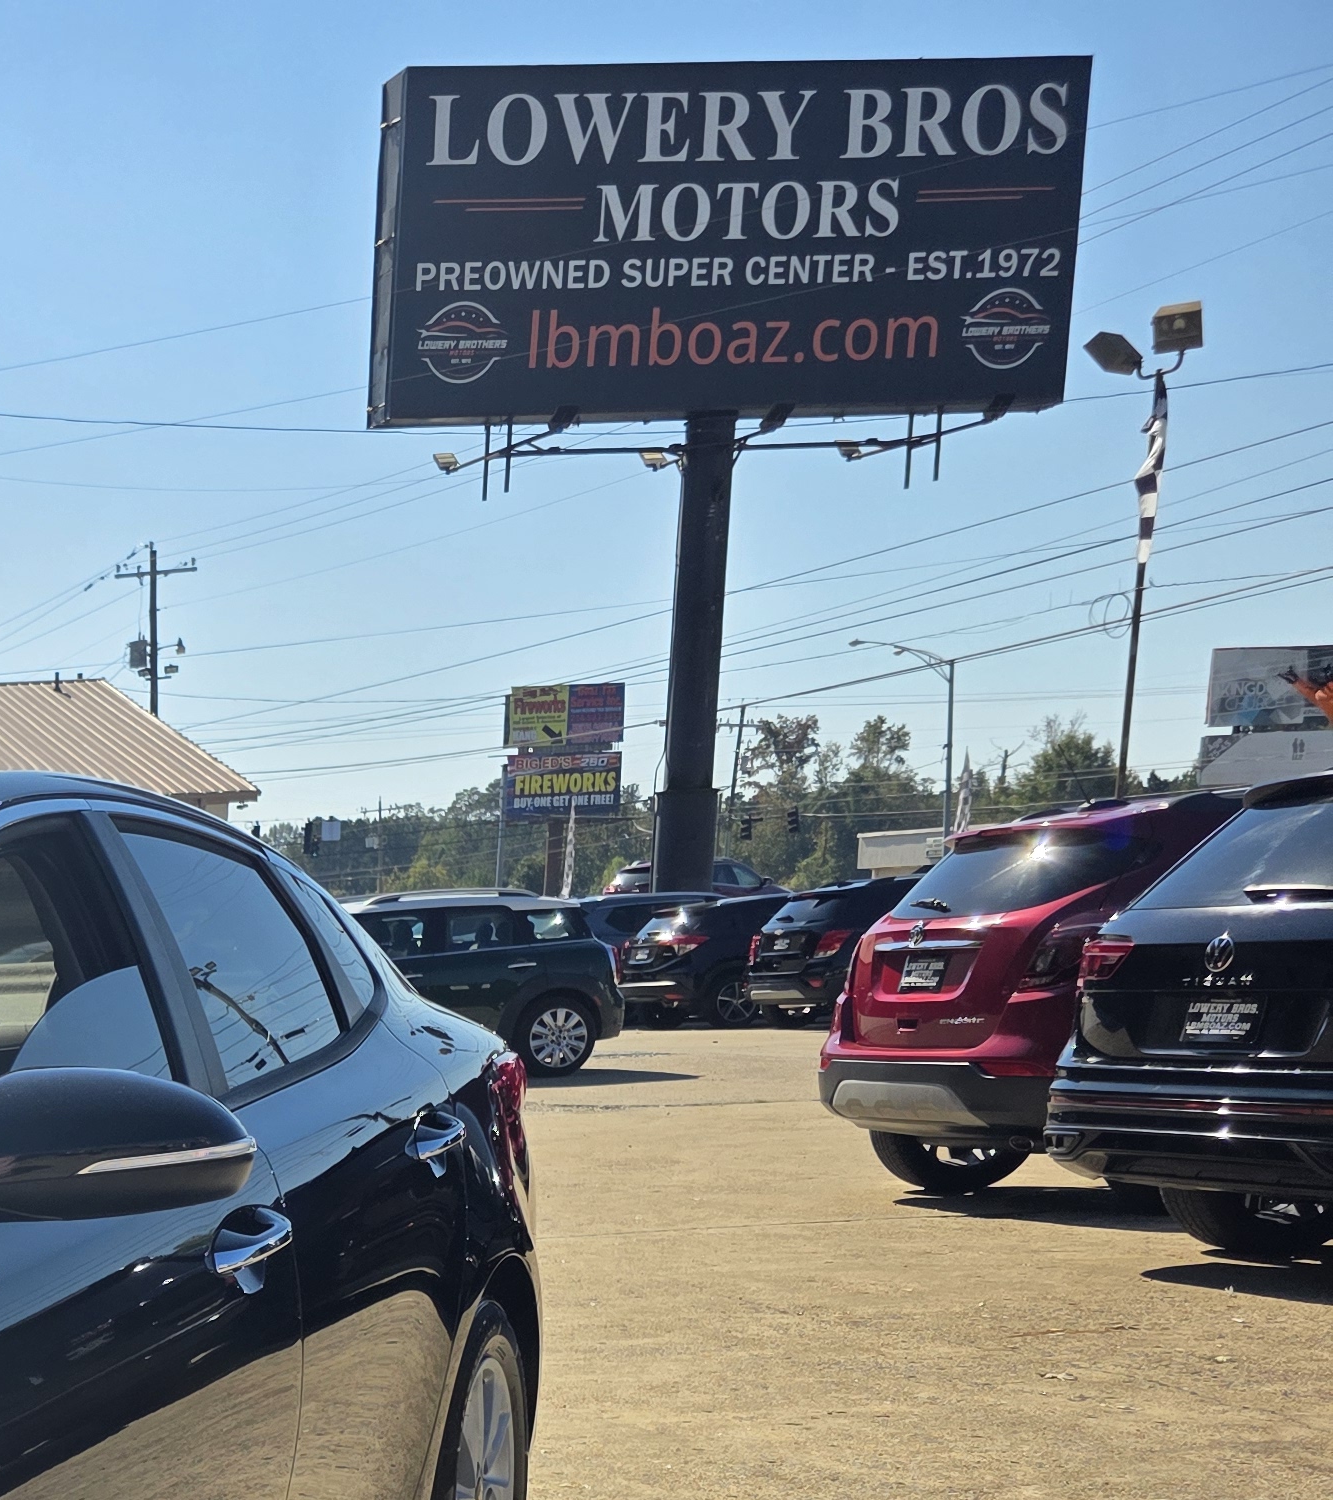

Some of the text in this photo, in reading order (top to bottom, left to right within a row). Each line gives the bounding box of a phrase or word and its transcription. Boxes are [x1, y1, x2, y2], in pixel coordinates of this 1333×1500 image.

[426, 82, 1070, 166] LOWERY BROS
[592, 177, 900, 242] MOTORS
[415, 259, 610, 291] PREOWNED
[621, 258, 734, 288] SUPER
[745, 253, 875, 285] CENTER
[907, 248, 1061, 281] EST.1972
[528, 307, 939, 369] lbmboaz.com
[961, 325, 1051, 337] LOWERY BROTHERS
[418, 339, 508, 350] LOWERY BROTHERS
[515, 757, 540, 770] BIG
[541, 755, 572, 769] ED'S
[514, 771, 617, 796] FIREWORKS
[533, 796, 552, 807] ONE
[553, 795, 570, 807] GET
[590, 793, 615, 805] FREE!
[1188, 1002, 1259, 1014] LOWERY BROS.
[1201, 1013, 1240, 1022] MOTORS
